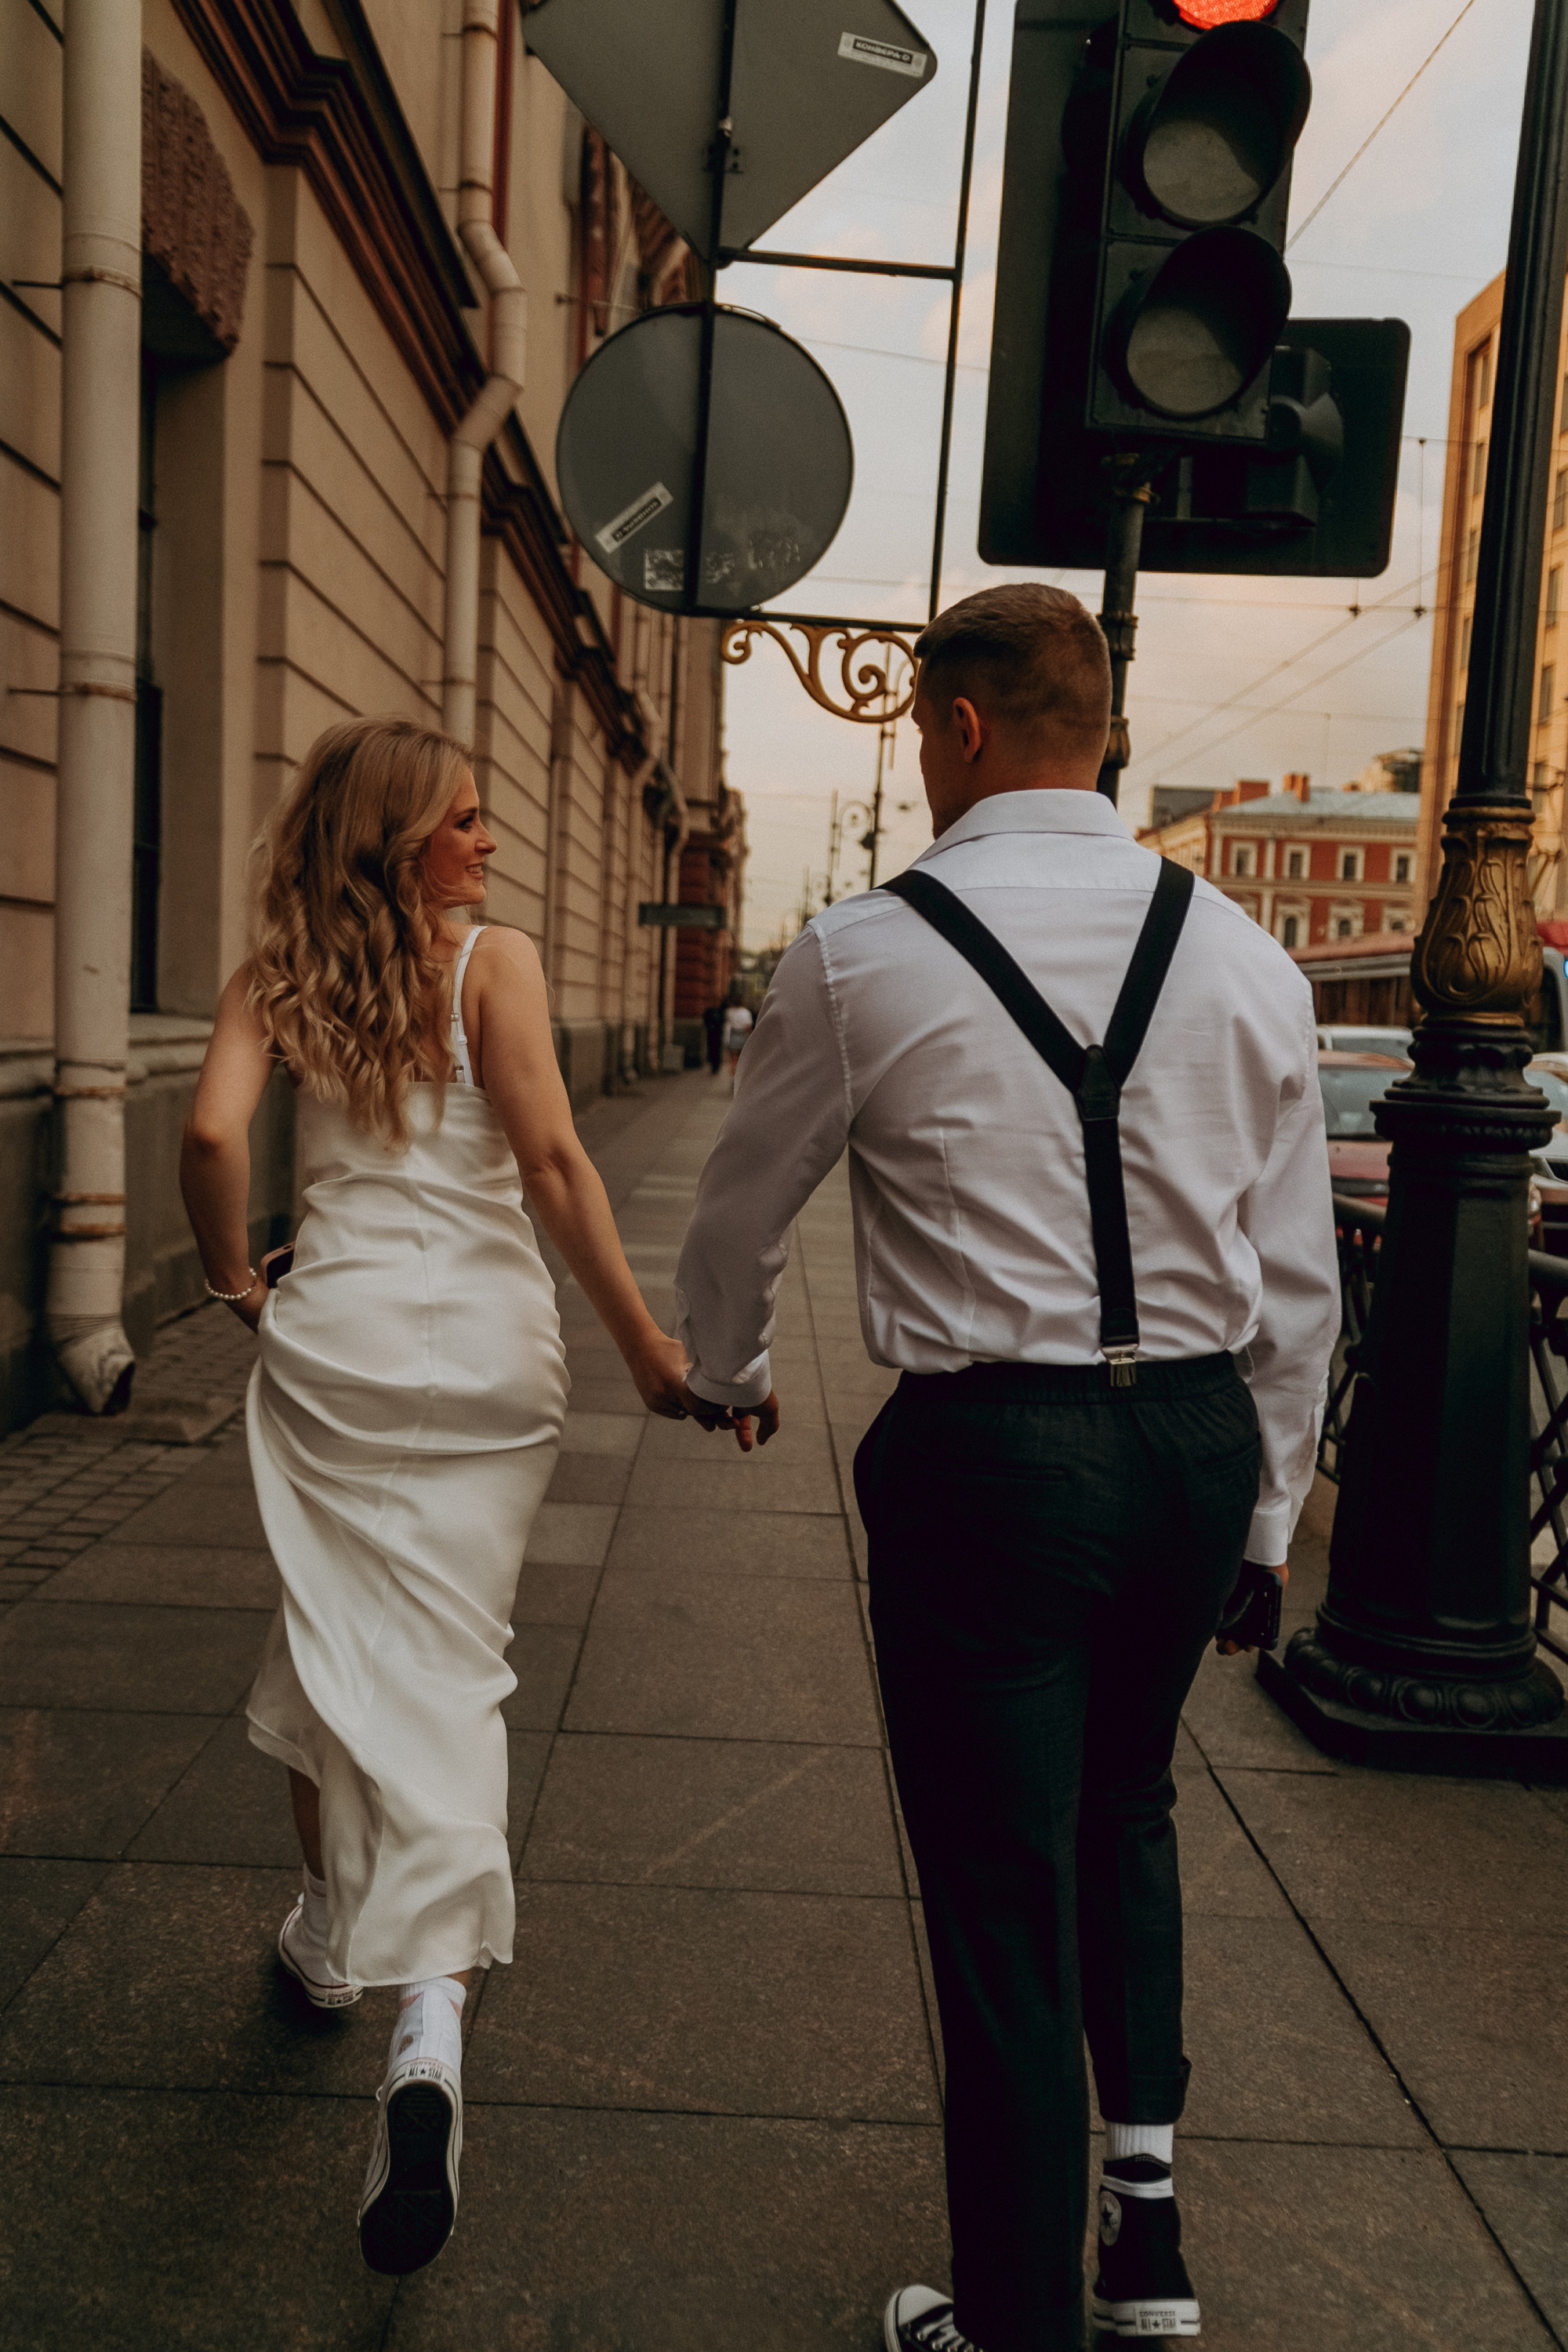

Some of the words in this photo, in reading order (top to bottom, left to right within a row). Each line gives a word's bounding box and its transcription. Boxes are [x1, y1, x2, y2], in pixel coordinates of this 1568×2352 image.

[408, 2066, 418, 2077] ALL
[427, 2067, 442, 2080] STAR
[1141, 2318, 1151, 2331] ALL
